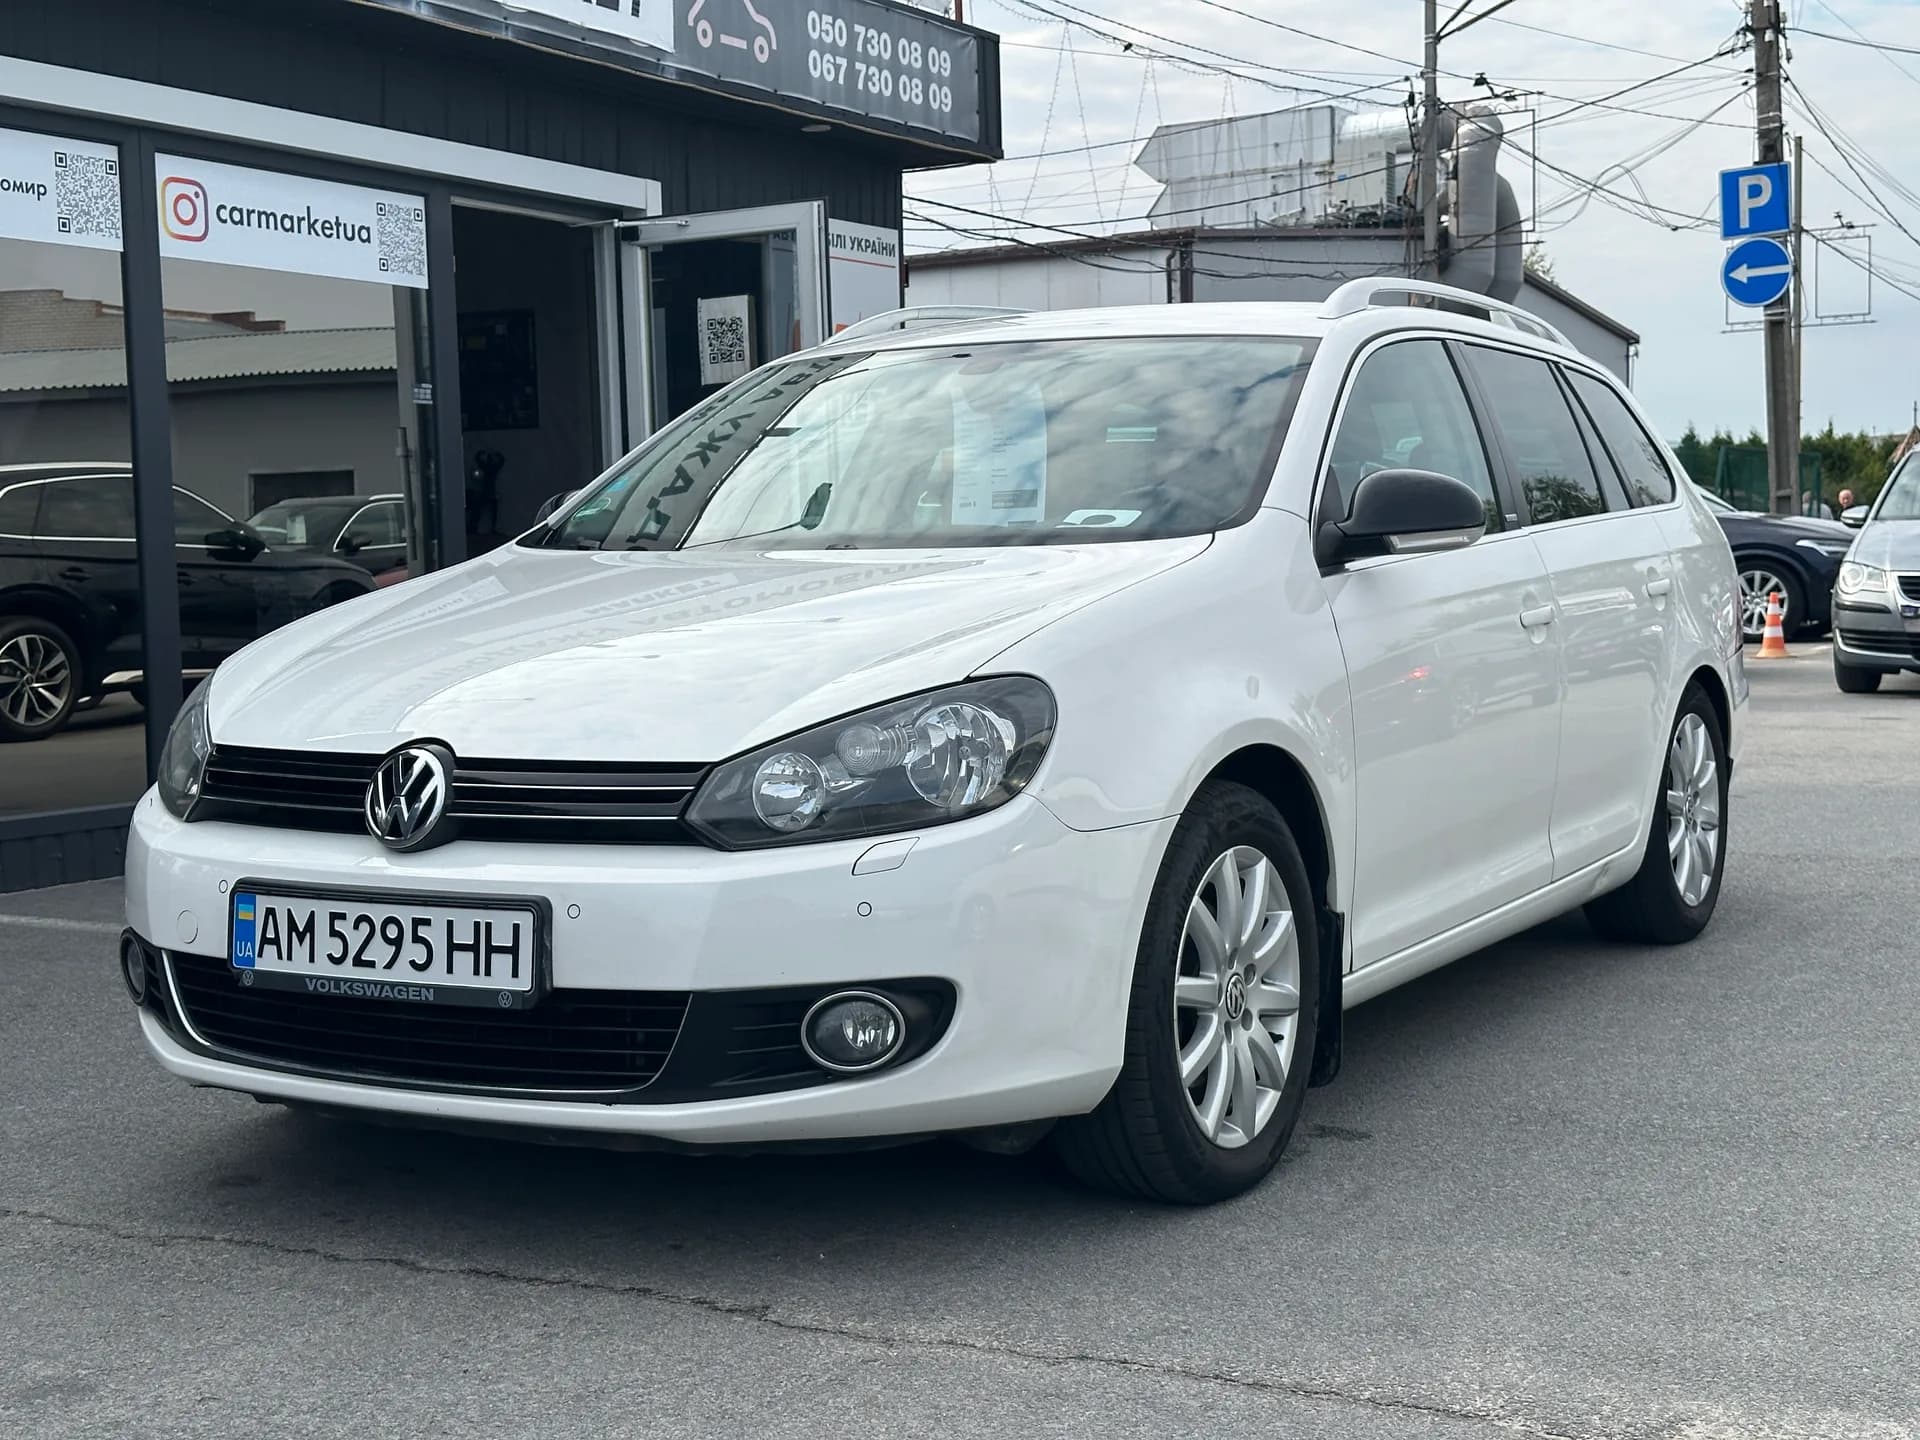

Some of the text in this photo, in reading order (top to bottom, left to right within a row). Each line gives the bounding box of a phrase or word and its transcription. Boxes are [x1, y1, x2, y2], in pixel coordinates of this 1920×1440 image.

[807, 10, 951, 77] 050 730 08 09
[808, 49, 952, 112] 067 730 08 09
[215, 203, 372, 244] carmarketua
[1738, 174, 1773, 229] P
[849, 236, 896, 258] УКРАЇНИ
[237, 940, 253, 957] UA
[257, 907, 521, 978] AM 5295 HH
[304, 977, 434, 1001] VOLKSWAGEN
